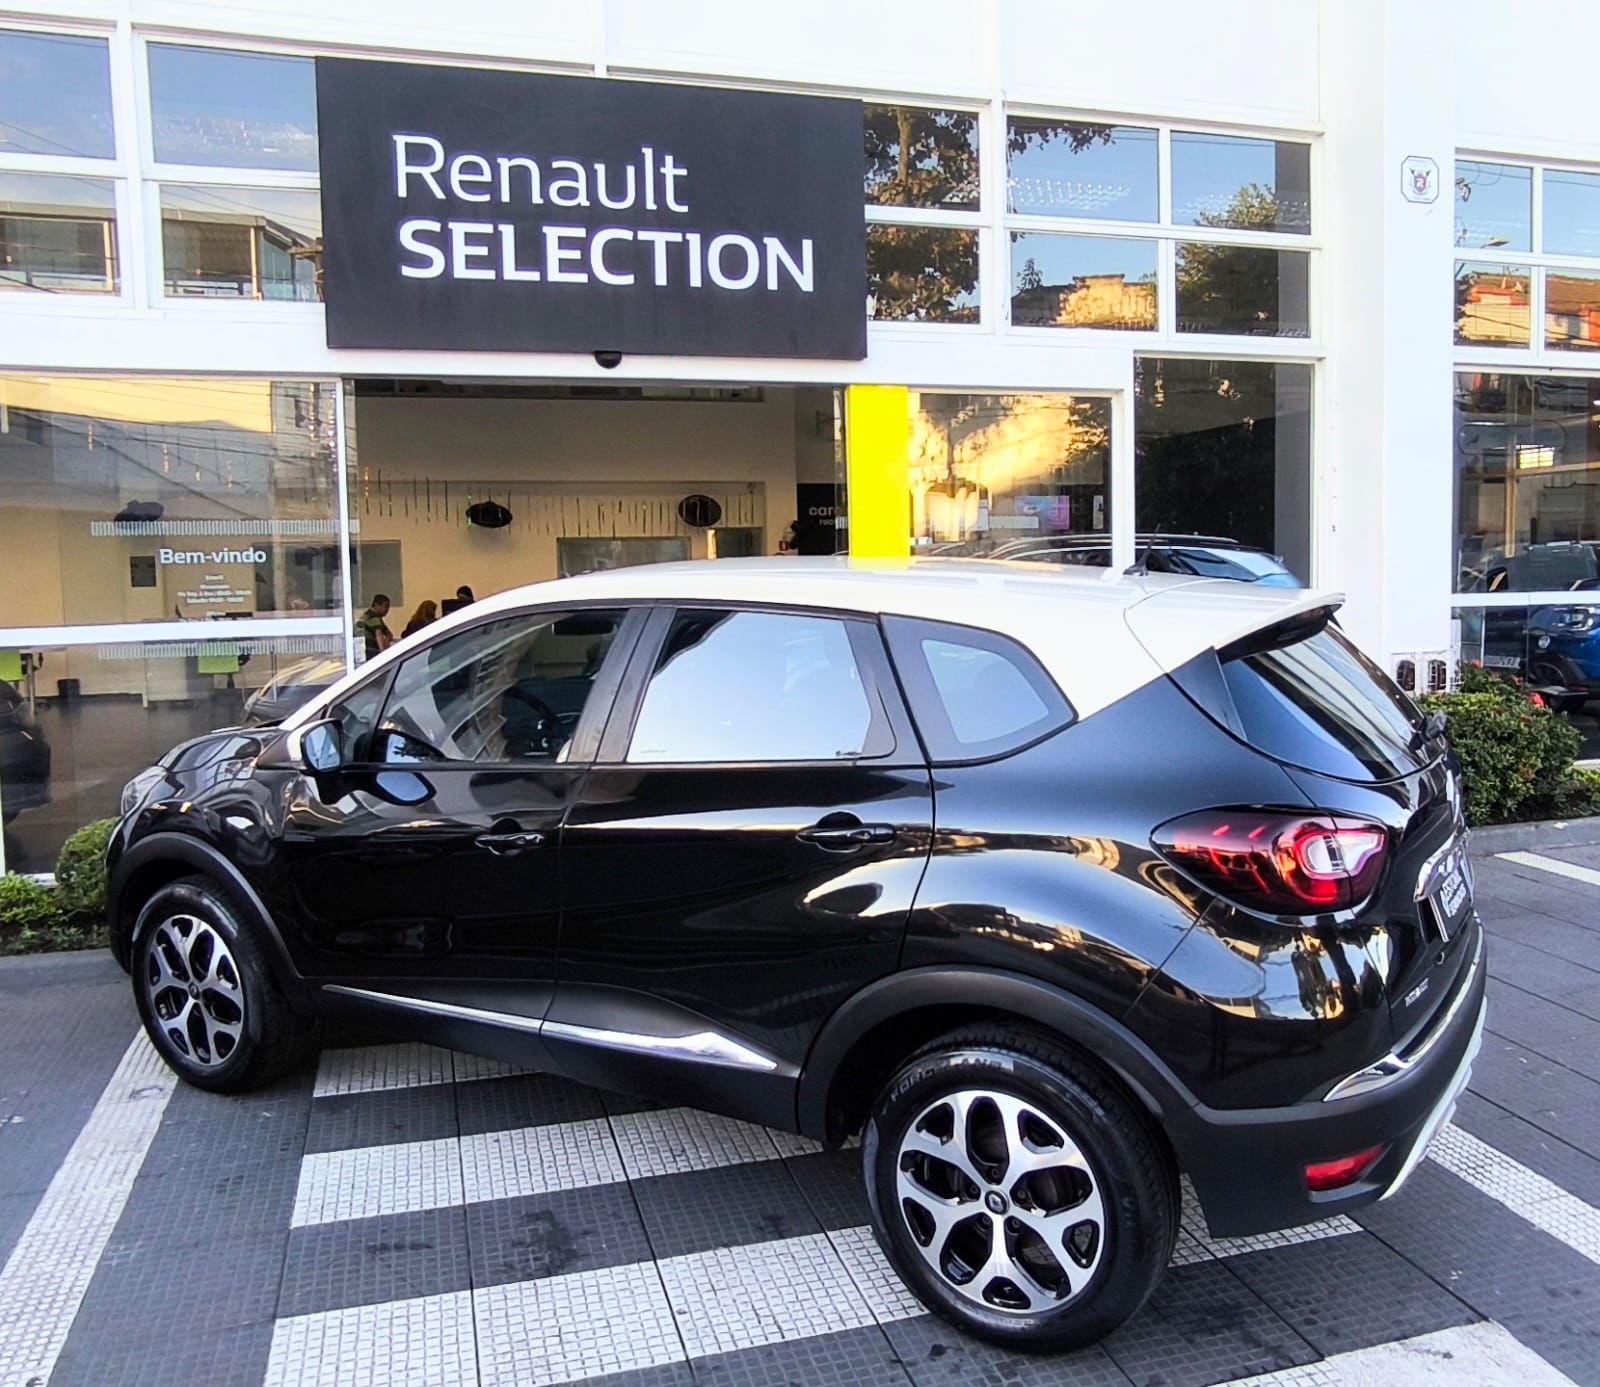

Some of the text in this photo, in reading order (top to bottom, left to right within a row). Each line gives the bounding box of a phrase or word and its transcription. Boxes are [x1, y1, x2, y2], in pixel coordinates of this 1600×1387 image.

[393, 134, 689, 213] Renault
[399, 219, 814, 292] SELECTION
[159, 547, 267, 564] Bem-vindo
